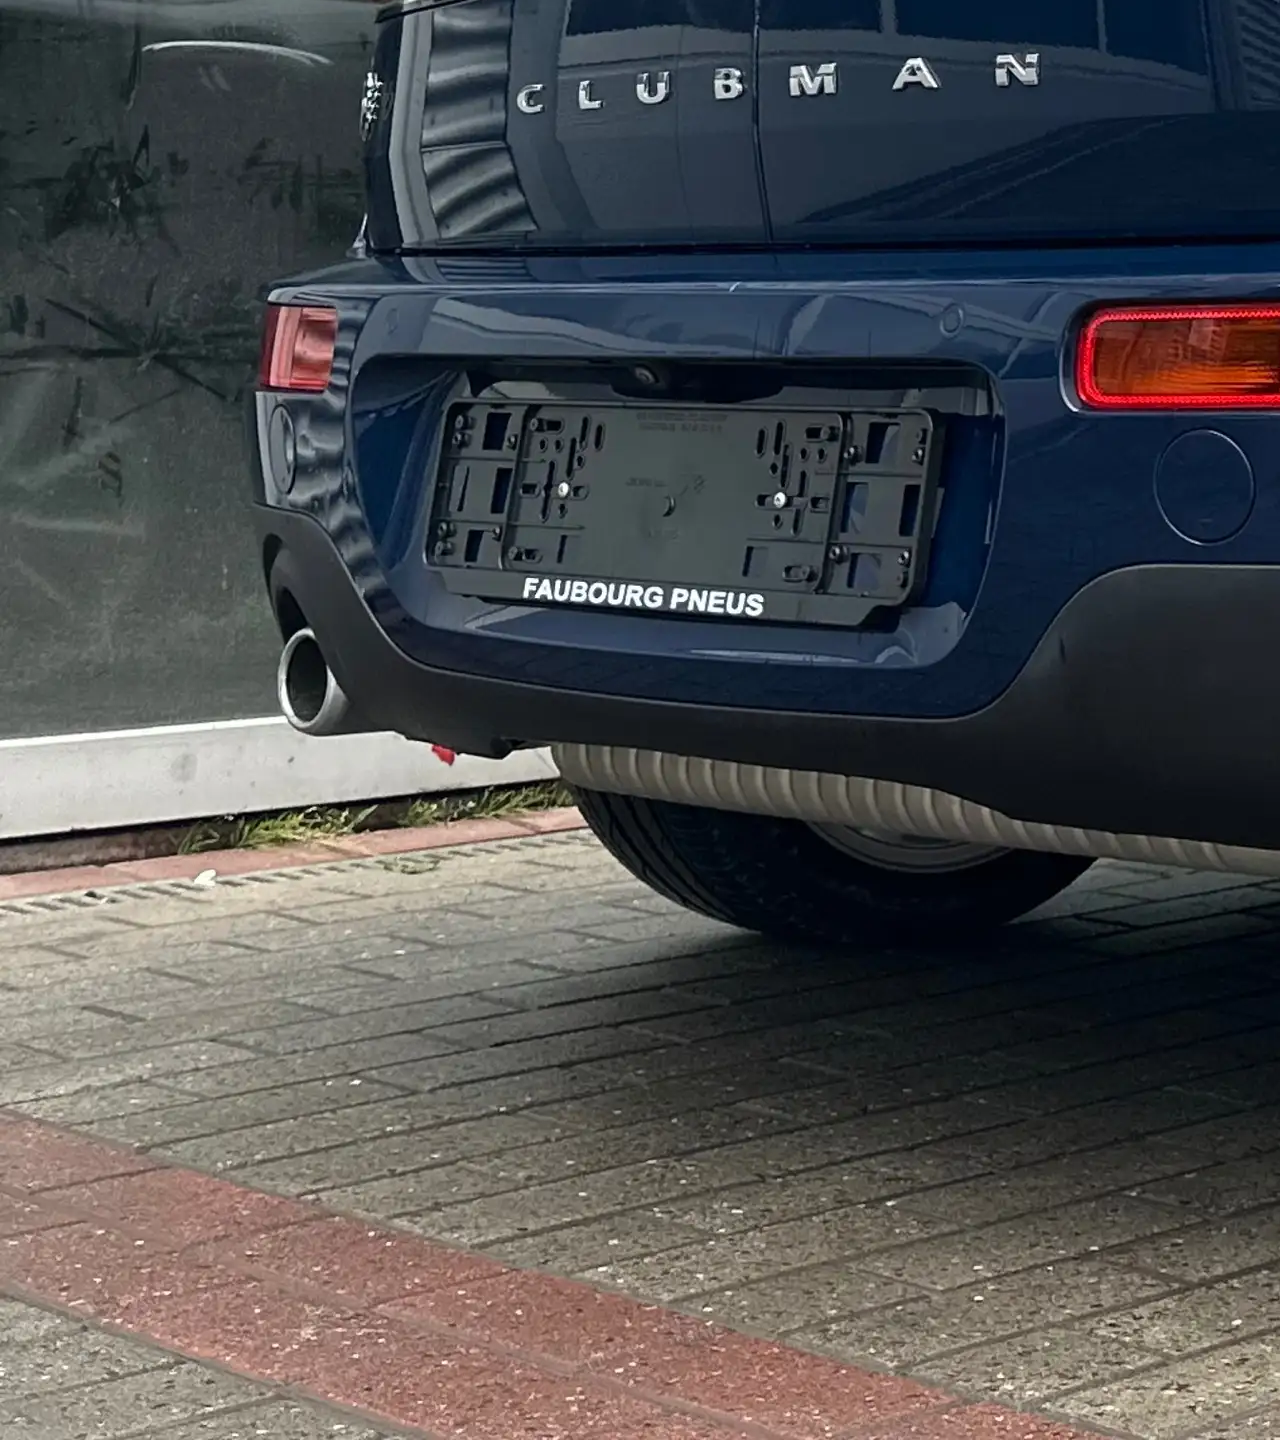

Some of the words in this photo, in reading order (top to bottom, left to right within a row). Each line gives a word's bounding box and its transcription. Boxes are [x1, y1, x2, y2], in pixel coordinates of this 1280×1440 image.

[516, 53, 1040, 114] CLUBMAN
[522, 577, 664, 608] FAUBOURG
[670, 587, 765, 617] PNEUS
